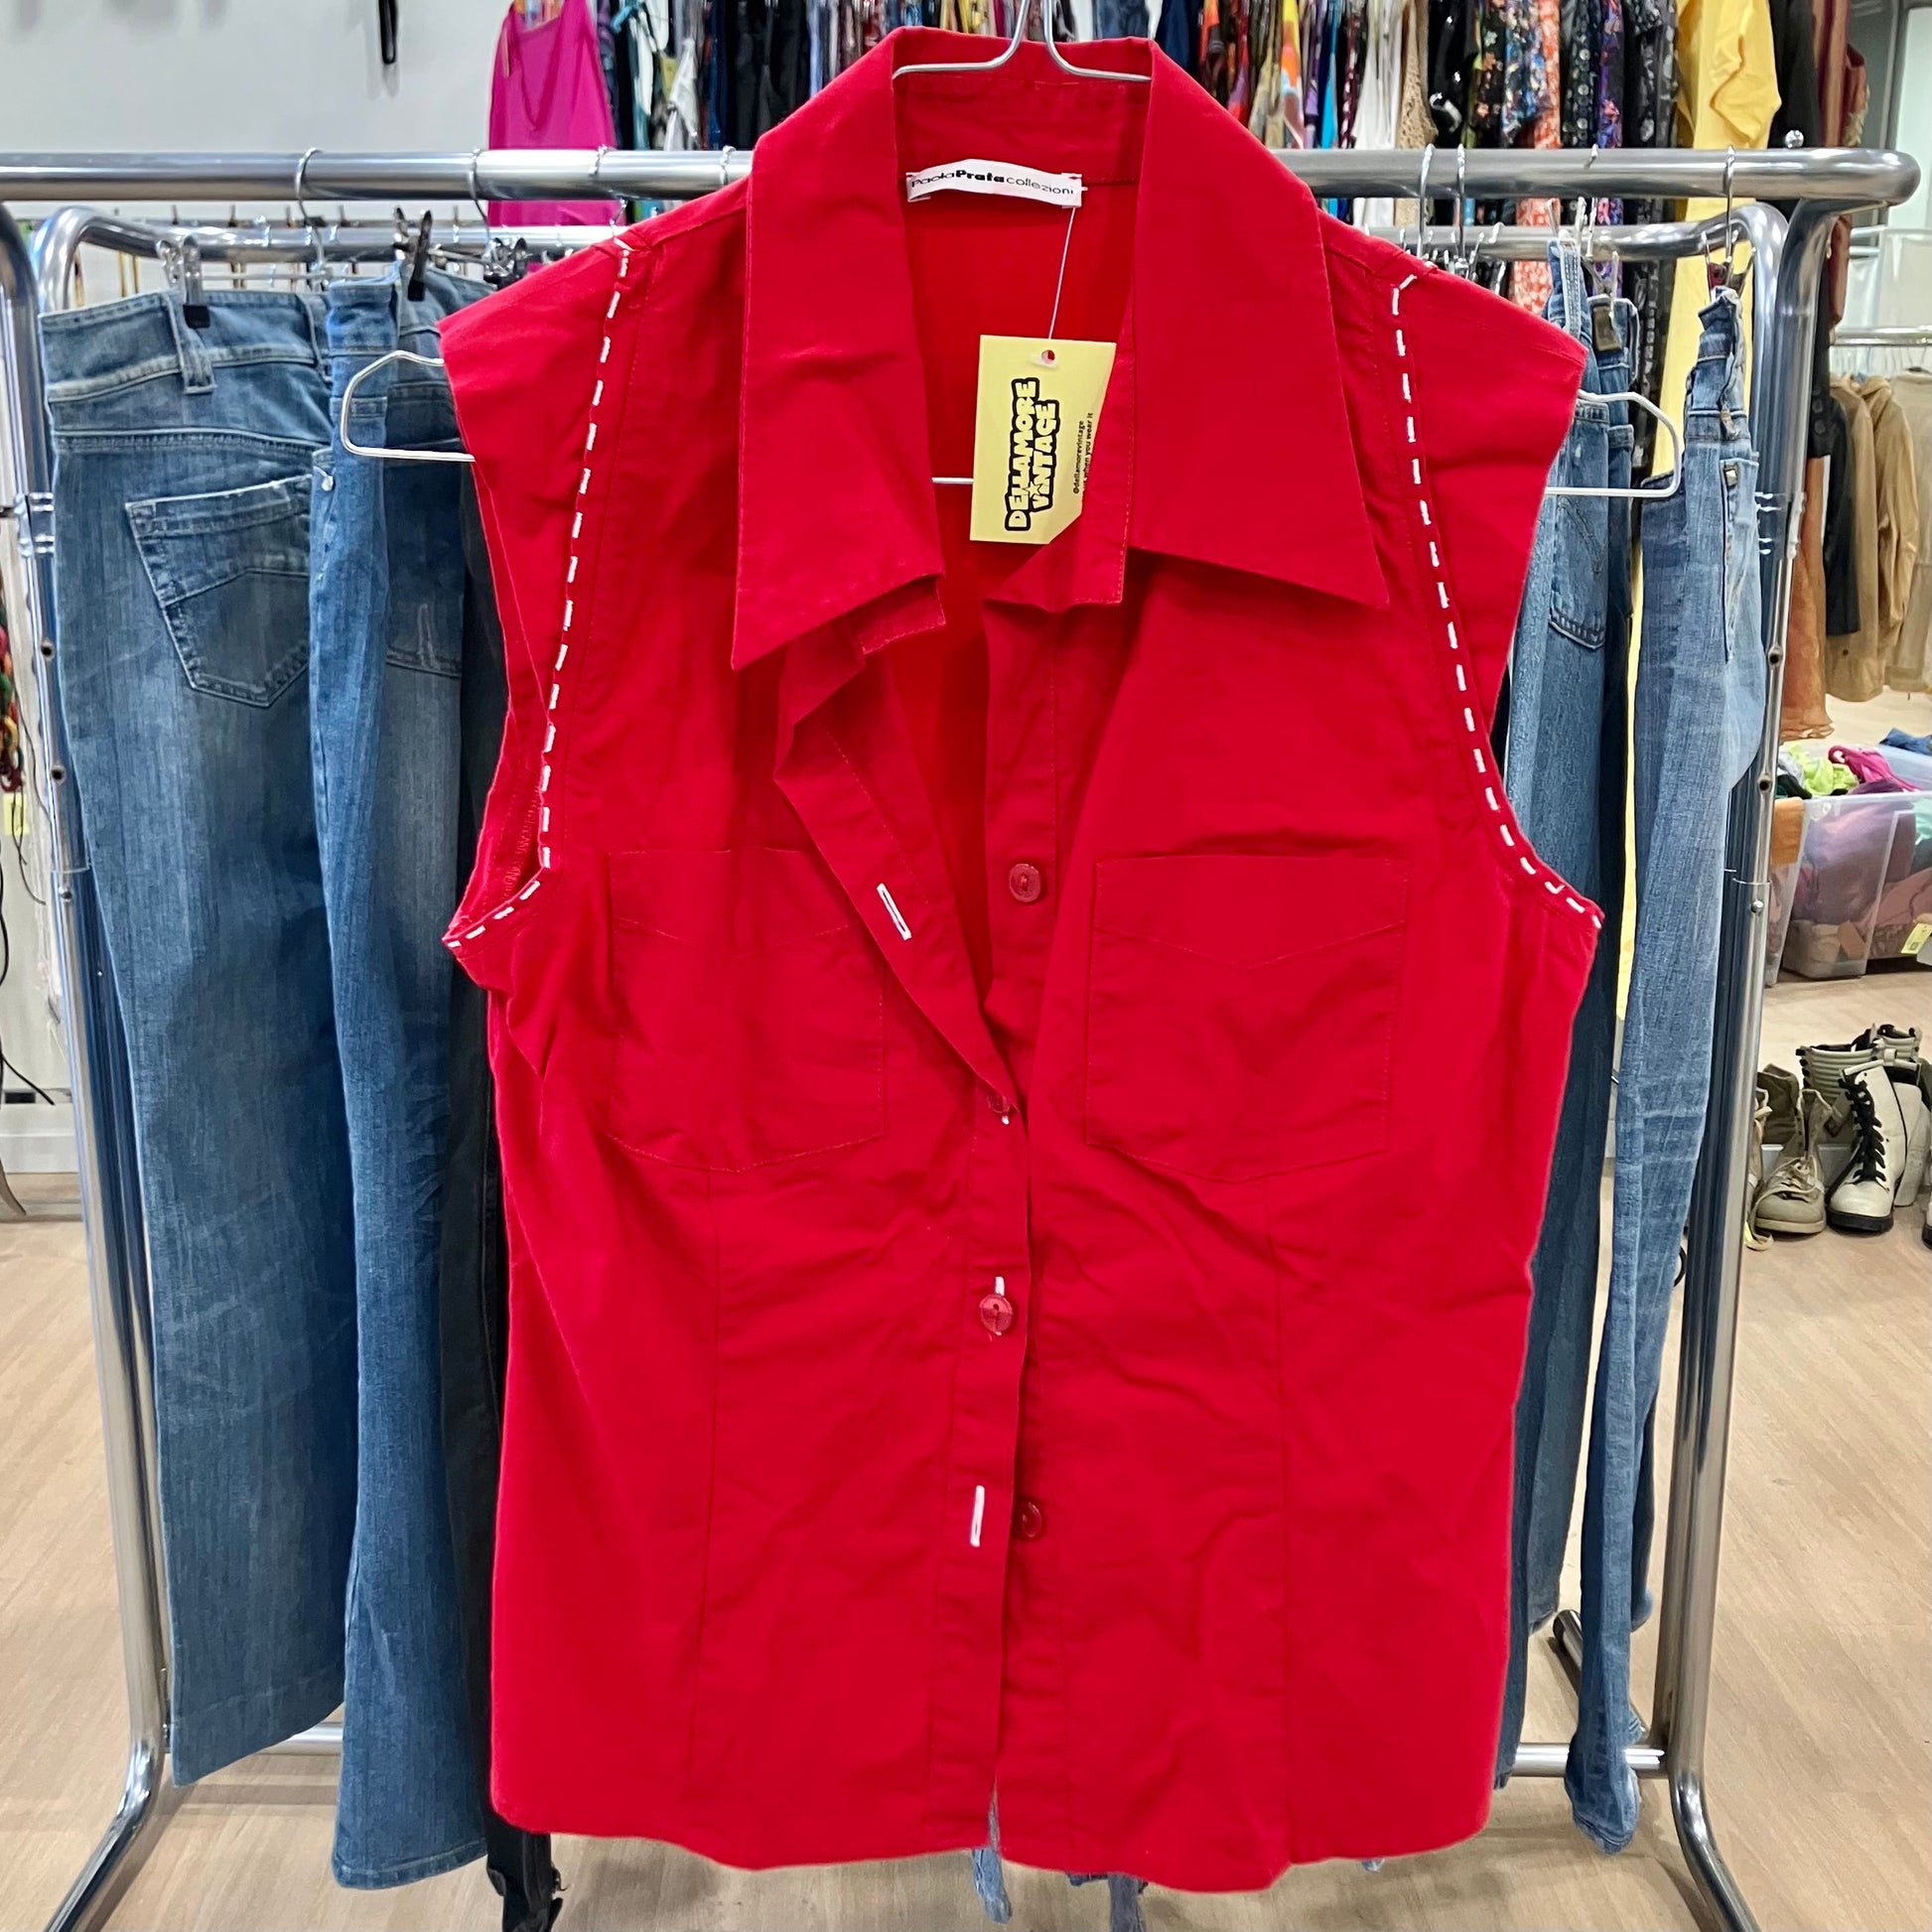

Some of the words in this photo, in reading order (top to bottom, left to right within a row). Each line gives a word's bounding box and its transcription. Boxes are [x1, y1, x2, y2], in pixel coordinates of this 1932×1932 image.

[1005, 377, 1039, 531] DELLAMORE
[1029, 399, 1060, 512] VINTAGE
[1073, 420, 1085, 493] @dellamorevintage
